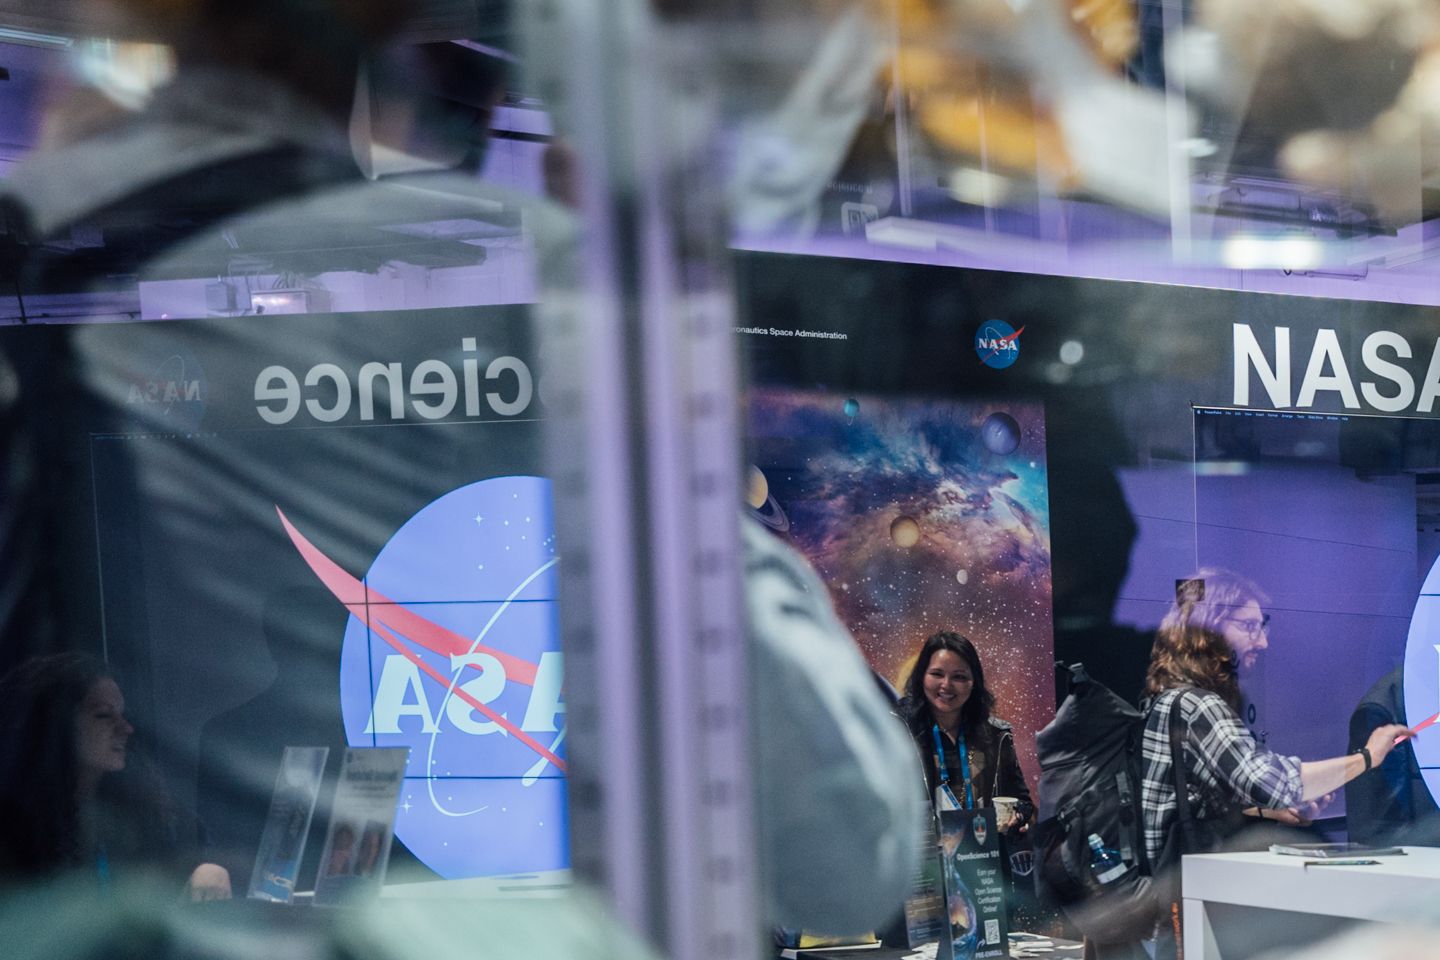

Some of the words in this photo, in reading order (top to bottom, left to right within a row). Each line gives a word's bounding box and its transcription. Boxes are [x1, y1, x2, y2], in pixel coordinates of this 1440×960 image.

[735, 326, 768, 335] onautics
[769, 328, 794, 337] Space
[795, 330, 848, 340] Administration
[979, 338, 1018, 352] NASA
